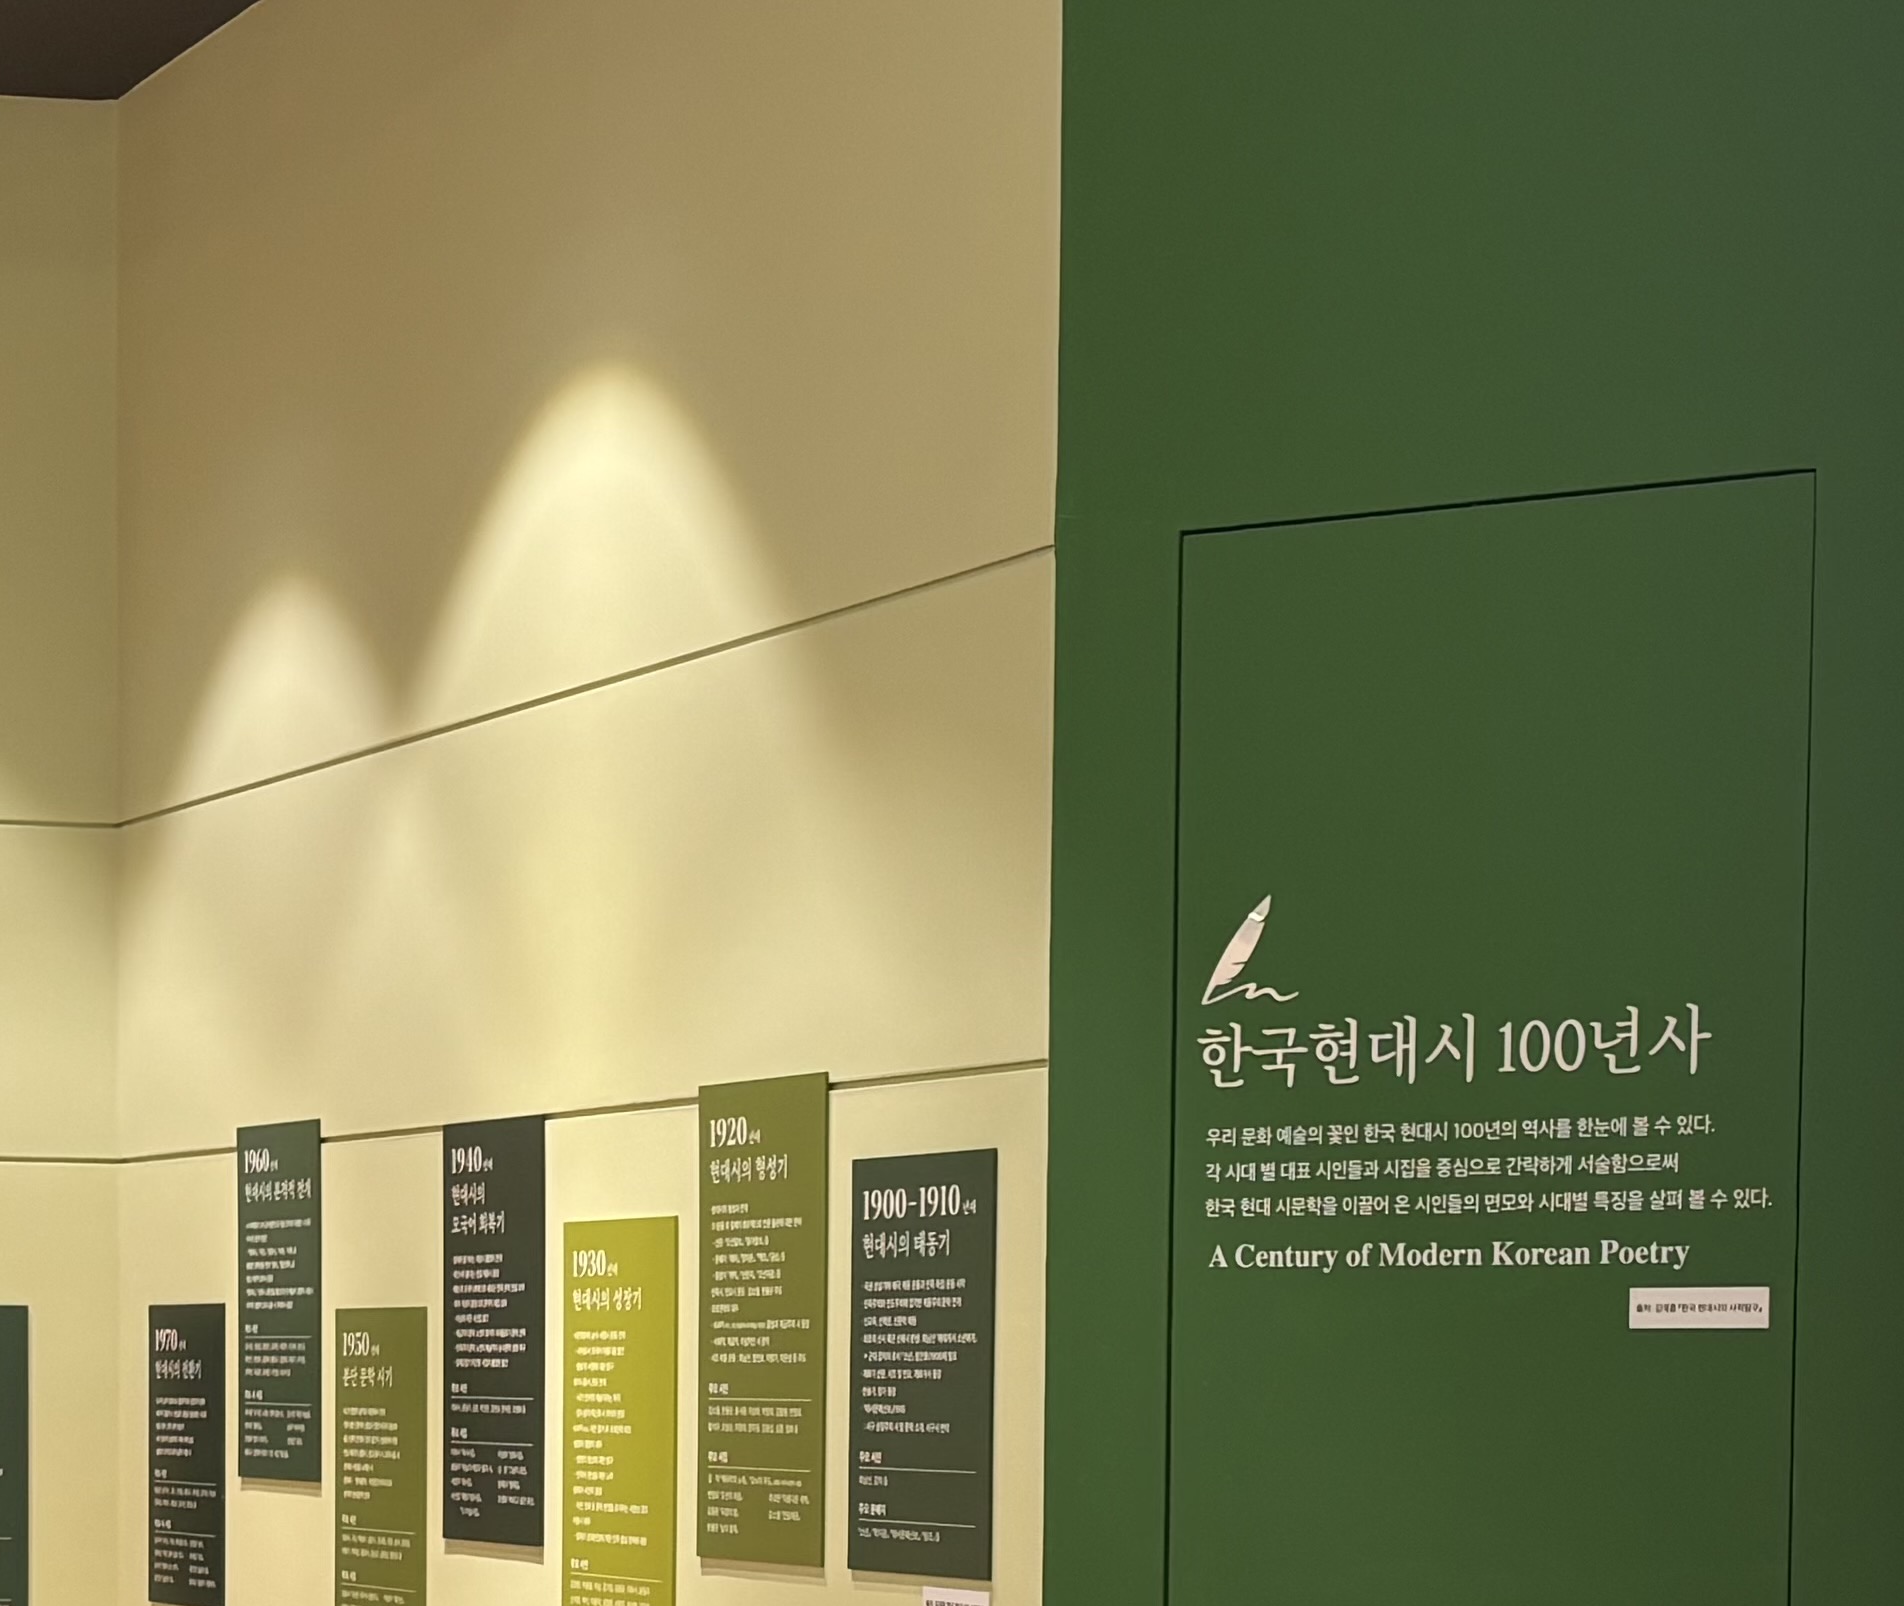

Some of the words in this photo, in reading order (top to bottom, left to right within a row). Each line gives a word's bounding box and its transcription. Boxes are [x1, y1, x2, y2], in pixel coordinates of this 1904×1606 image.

[1197, 1012, 1478, 1089] 한국현대시
[1497, 1003, 1713, 1076] 100년사
[1206, 1127, 1237, 1147] 우리
[1241, 1126, 1272, 1146] 문화
[1276, 1125, 1323, 1146] 예술의
[1326, 1124, 1359, 1145] 꽃인
[1363, 1123, 1396, 1143] 한국
[1400, 1121, 1449, 1142] 현대시
[1454, 1120, 1517, 1141] 100년의
[1522, 1118, 1571, 1139] 역사를
[1577, 1117, 1627, 1138] 한눈에
[1632, 1116, 1649, 1136] 볼
[1654, 1117, 1672, 1136] 수
[1677, 1114, 1715, 1135] 있다.
[709, 1158, 752, 1183] 현대시의
[755, 1154, 788, 1180] 형성기
[1205, 1163, 1220, 1182] 각
[1225, 1163, 1256, 1182] 시대
[1260, 1162, 1276, 1182] 별
[1280, 1162, 1312, 1180] 대표
[1316, 1160, 1379, 1180] 시인들과
[1384, 1158, 1432, 1179] 시집을
[1436, 1157, 1501, 1178] 중심으로
[1506, 1155, 1572, 1176] 간략하게
[1577, 1152, 1679, 1175] 서술함으로써
[1205, 1198, 1236, 1217] 한국
[1240, 1197, 1271, 1217] 현대
[1276, 1196, 1338, 1216] 시문학을
[1342, 1195, 1389, 1215] 이끌어
[1394, 1195, 1410, 1215] 온
[1415, 1193, 1479, 1214] 시인들의
[1484, 1192, 1534, 1213] 면모와
[1539, 1191, 1588, 1212] 시대별
[1593, 1190, 1644, 1211] 특징을
[1649, 1189, 1683, 1211] 살펴
[1688, 1188, 1705, 1210] 볼
[1710, 1188, 1728, 1210] 수
[1733, 1187, 1772, 1209] 있다.
[862, 1233, 913, 1260] 현대시의
[916, 1230, 950, 1257] 태동기
[1208, 1244, 1228, 1268] A
[1234, 1243, 1339, 1273] Century
[1346, 1242, 1372, 1268] of
[1378, 1242, 1483, 1267] Modern
[1491, 1240, 1590, 1266] Korean
[1599, 1239, 1690, 1270] Poetry
[572, 1287, 610, 1311] 현대시의
